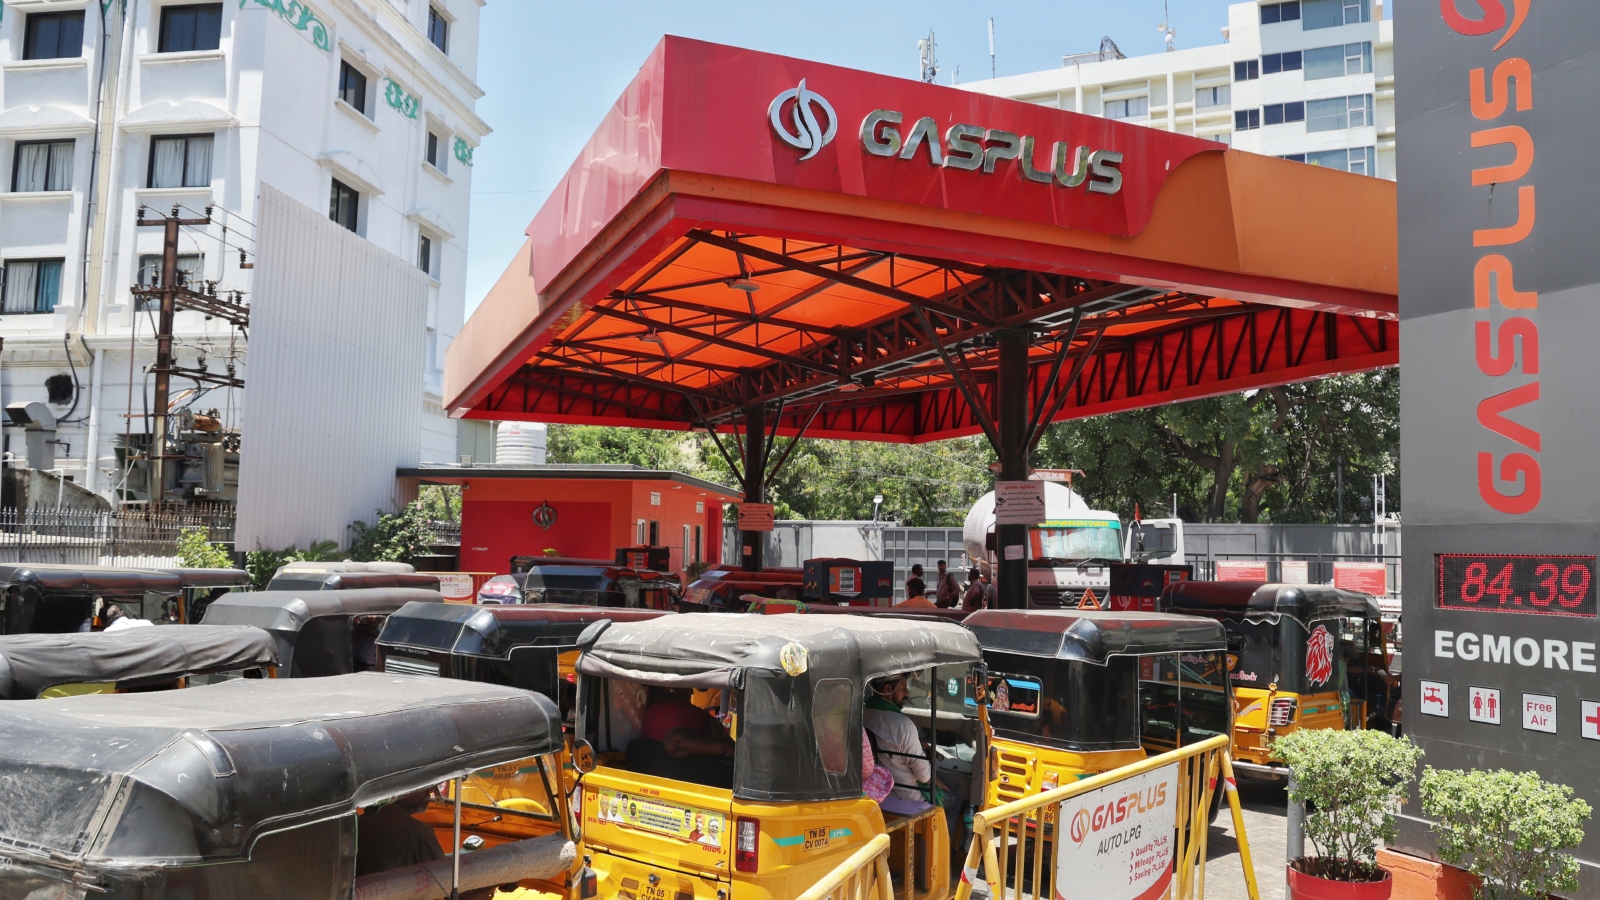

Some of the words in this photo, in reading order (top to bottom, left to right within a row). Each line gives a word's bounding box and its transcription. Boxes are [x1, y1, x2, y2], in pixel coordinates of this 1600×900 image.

[859, 108, 1124, 195] GASPLUS
[1469, 56, 1542, 515] GASPLUS
[1460, 562, 1591, 608] 84.39
[1434, 629, 1597, 673] EGMORE
[1526, 701, 1553, 713] Free
[1530, 714, 1548, 727] Air
[1092, 781, 1168, 832] GASPLUS
[805, 840, 813, 849] CV
[815, 838, 829, 847] 0074
[809, 830, 817, 839] TN
[819, 829, 826, 837] 05
[1097, 833, 1123, 857] AUTO
[1123, 824, 1142, 845] LPG
[1135, 843, 1154, 857] Quality
[1153, 836, 1168, 848] PLUS
[1135, 855, 1155, 870] Mileage
[1155, 846, 1169, 860] PLUS
[1133, 868, 1151, 881] Saving
[1151, 860, 1166, 873] PLUS
[646, 886, 655, 895] TN
[656, 888, 664, 898] 05
